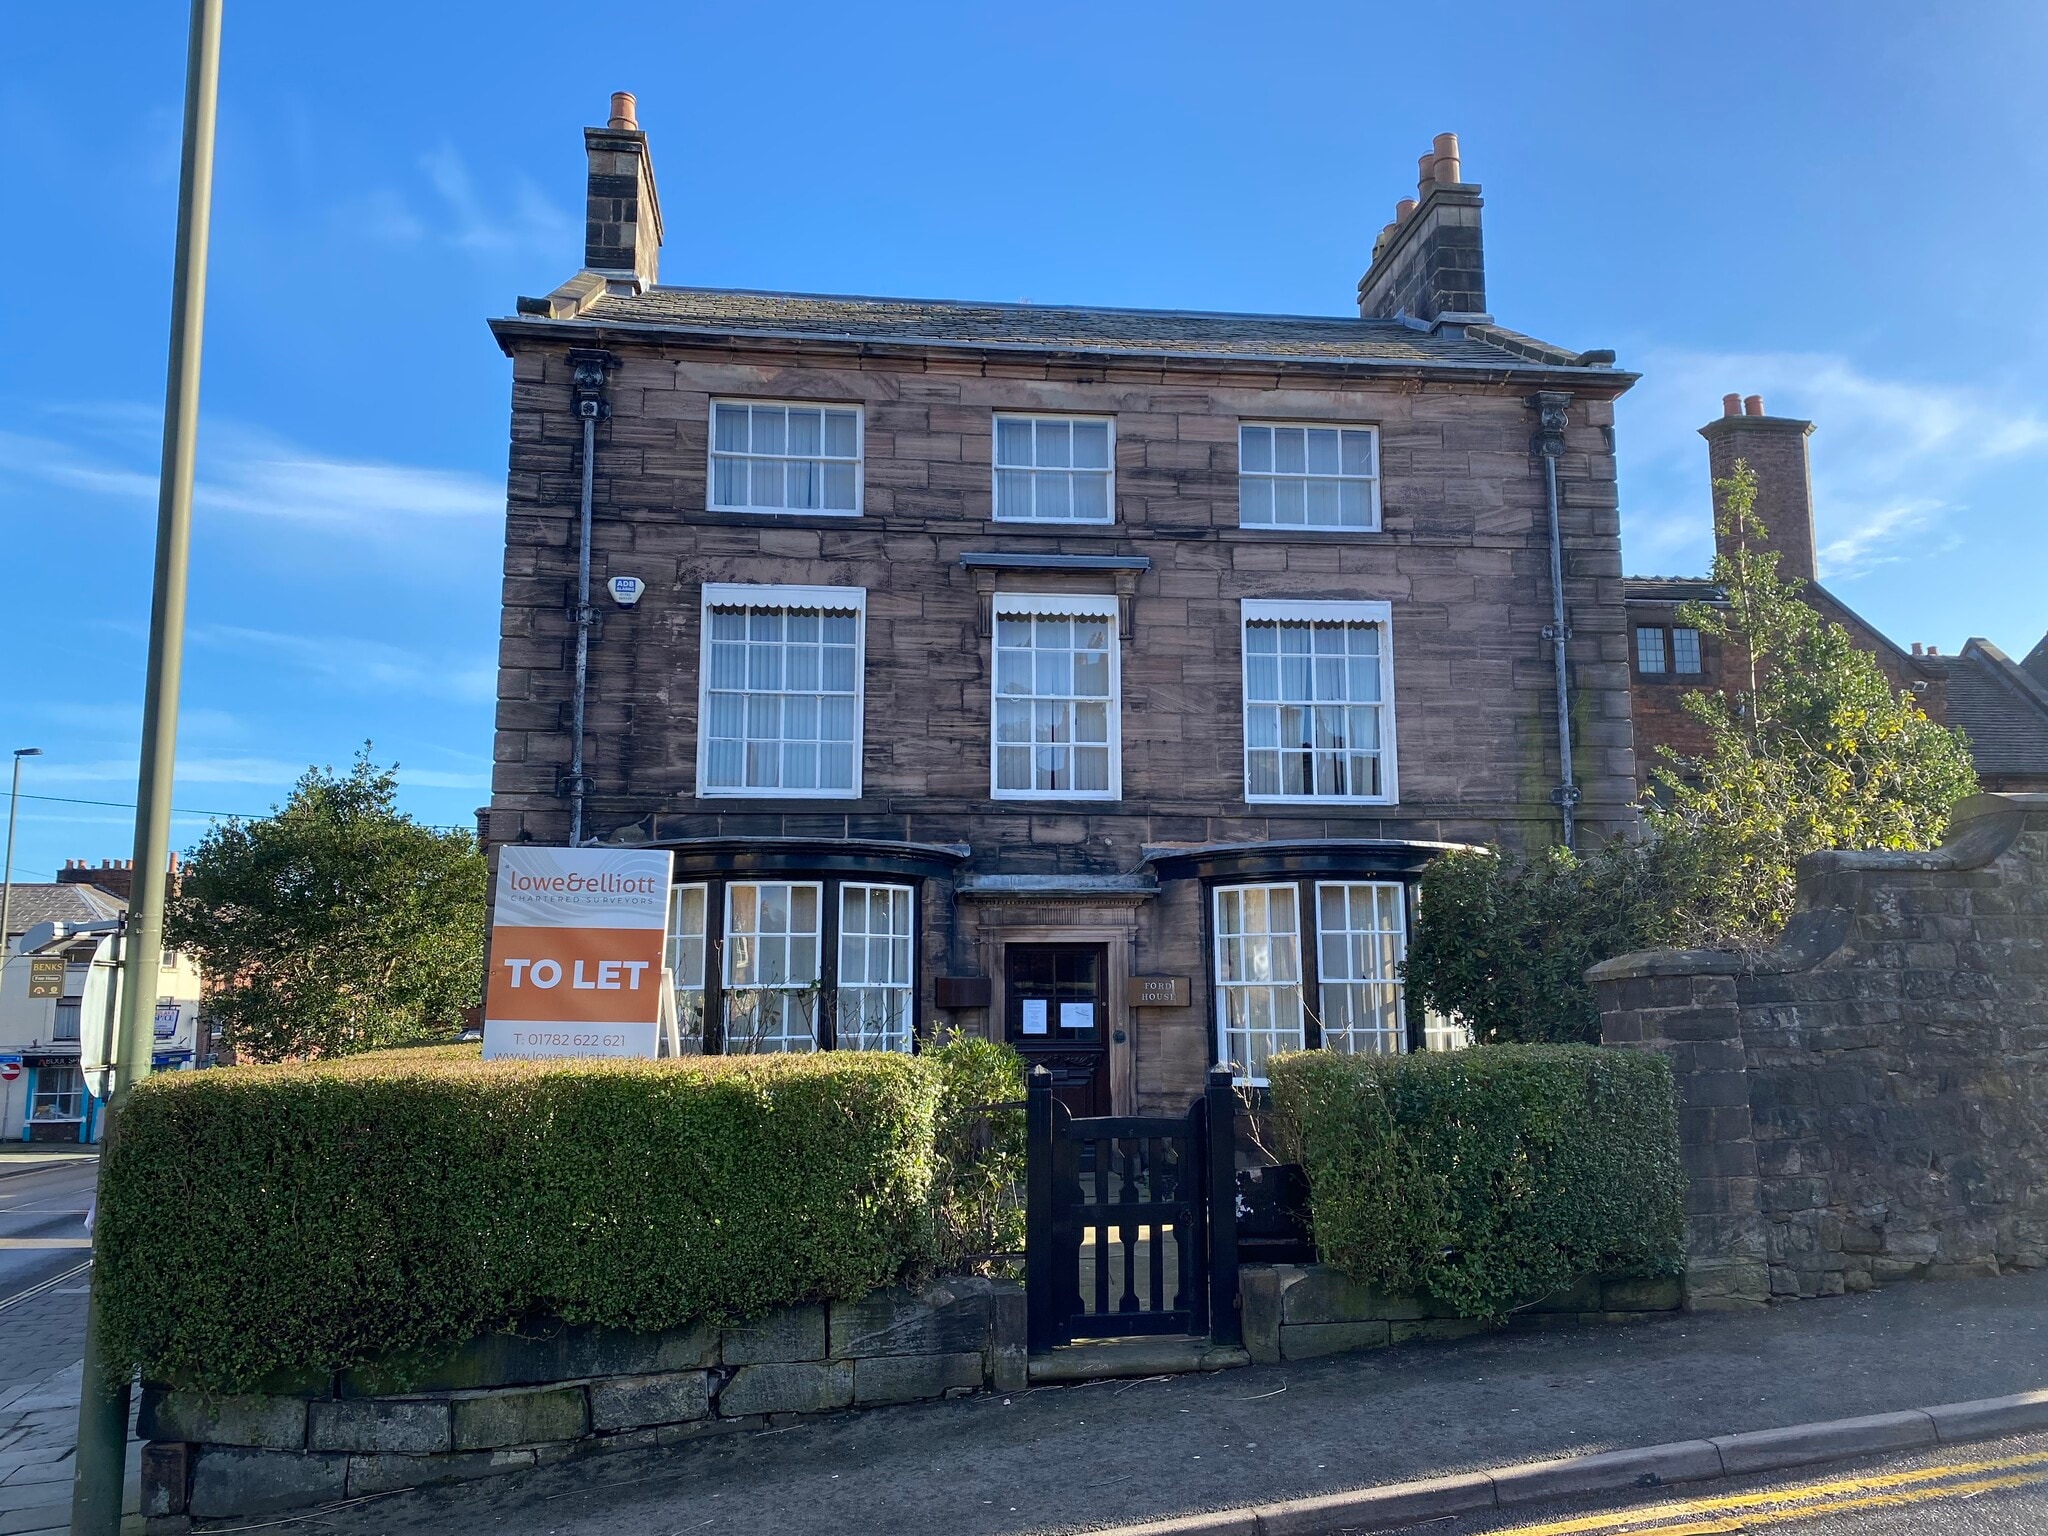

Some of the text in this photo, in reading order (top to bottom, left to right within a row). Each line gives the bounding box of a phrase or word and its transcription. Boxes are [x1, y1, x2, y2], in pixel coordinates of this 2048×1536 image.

[511, 871, 655, 893] lowe&elliott
[511, 895, 653, 905] CHARTERED SURVEYORS
[33, 963, 63, 971] BENKS
[504, 959, 649, 990] TO LET
[1141, 993, 1176, 1001] HOUSE
[514, 1033, 625, 1047] T: 01782 622 621
